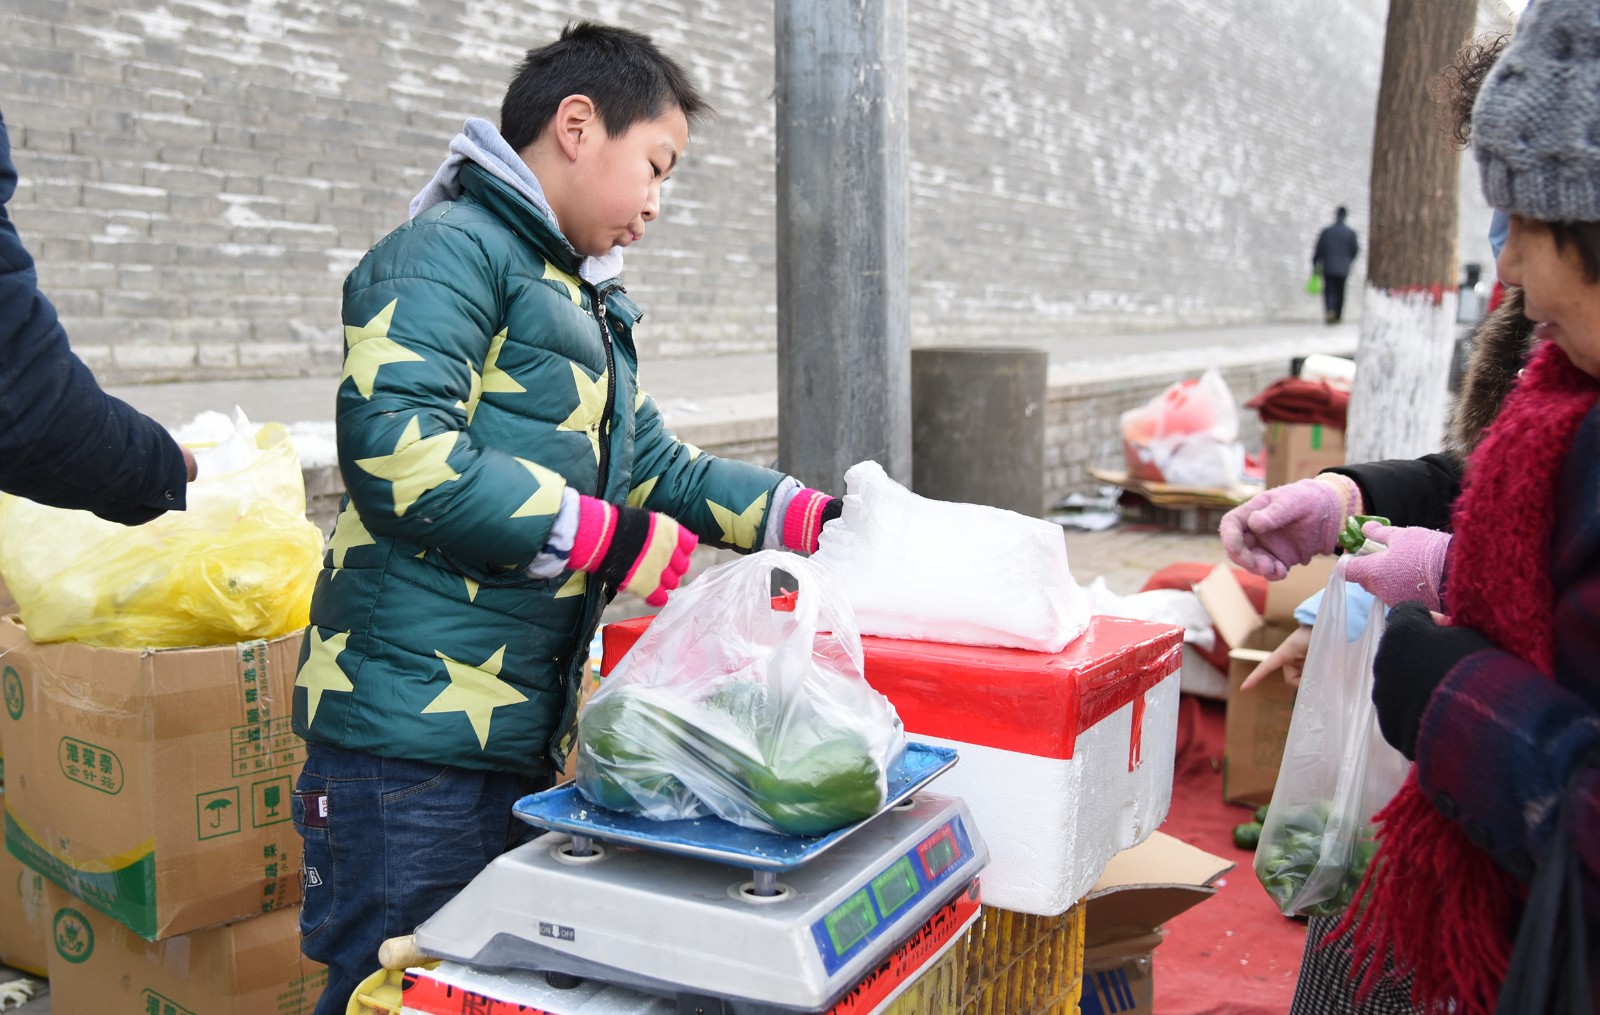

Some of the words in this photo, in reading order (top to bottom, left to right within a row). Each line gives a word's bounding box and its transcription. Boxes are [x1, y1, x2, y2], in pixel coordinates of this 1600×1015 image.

[66, 764, 115, 790] 金针菇
[540, 925, 551, 935] ON
[560, 929, 574, 939] OFF
